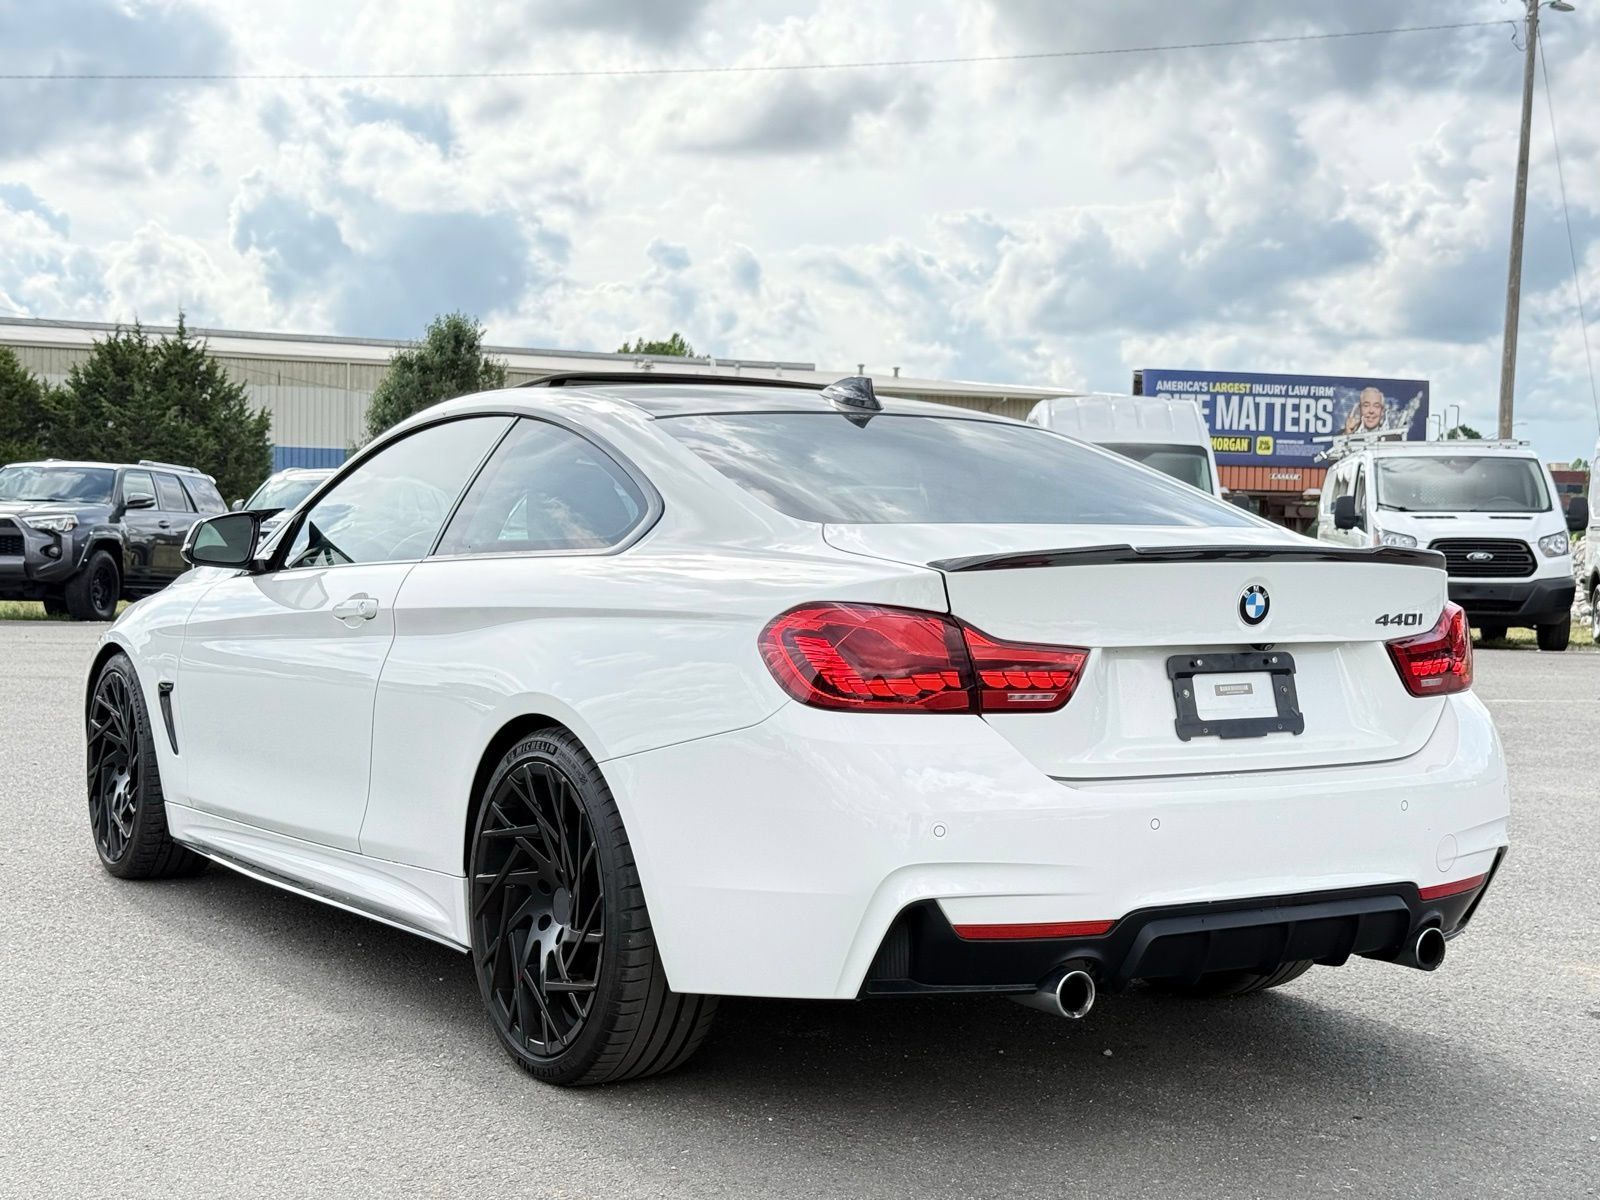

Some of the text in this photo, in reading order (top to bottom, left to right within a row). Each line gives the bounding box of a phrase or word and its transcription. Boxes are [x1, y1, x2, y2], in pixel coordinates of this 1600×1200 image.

[1156, 381, 1334, 397] AMERICA'S LARGEST INJURY LAW FIRM
[1215, 395, 1333, 433] MATTERS
[1211, 437, 1249, 451] MORGAN
[1243, 585, 1269, 599] BMW
[516, 741, 557, 755] MICHELIN
